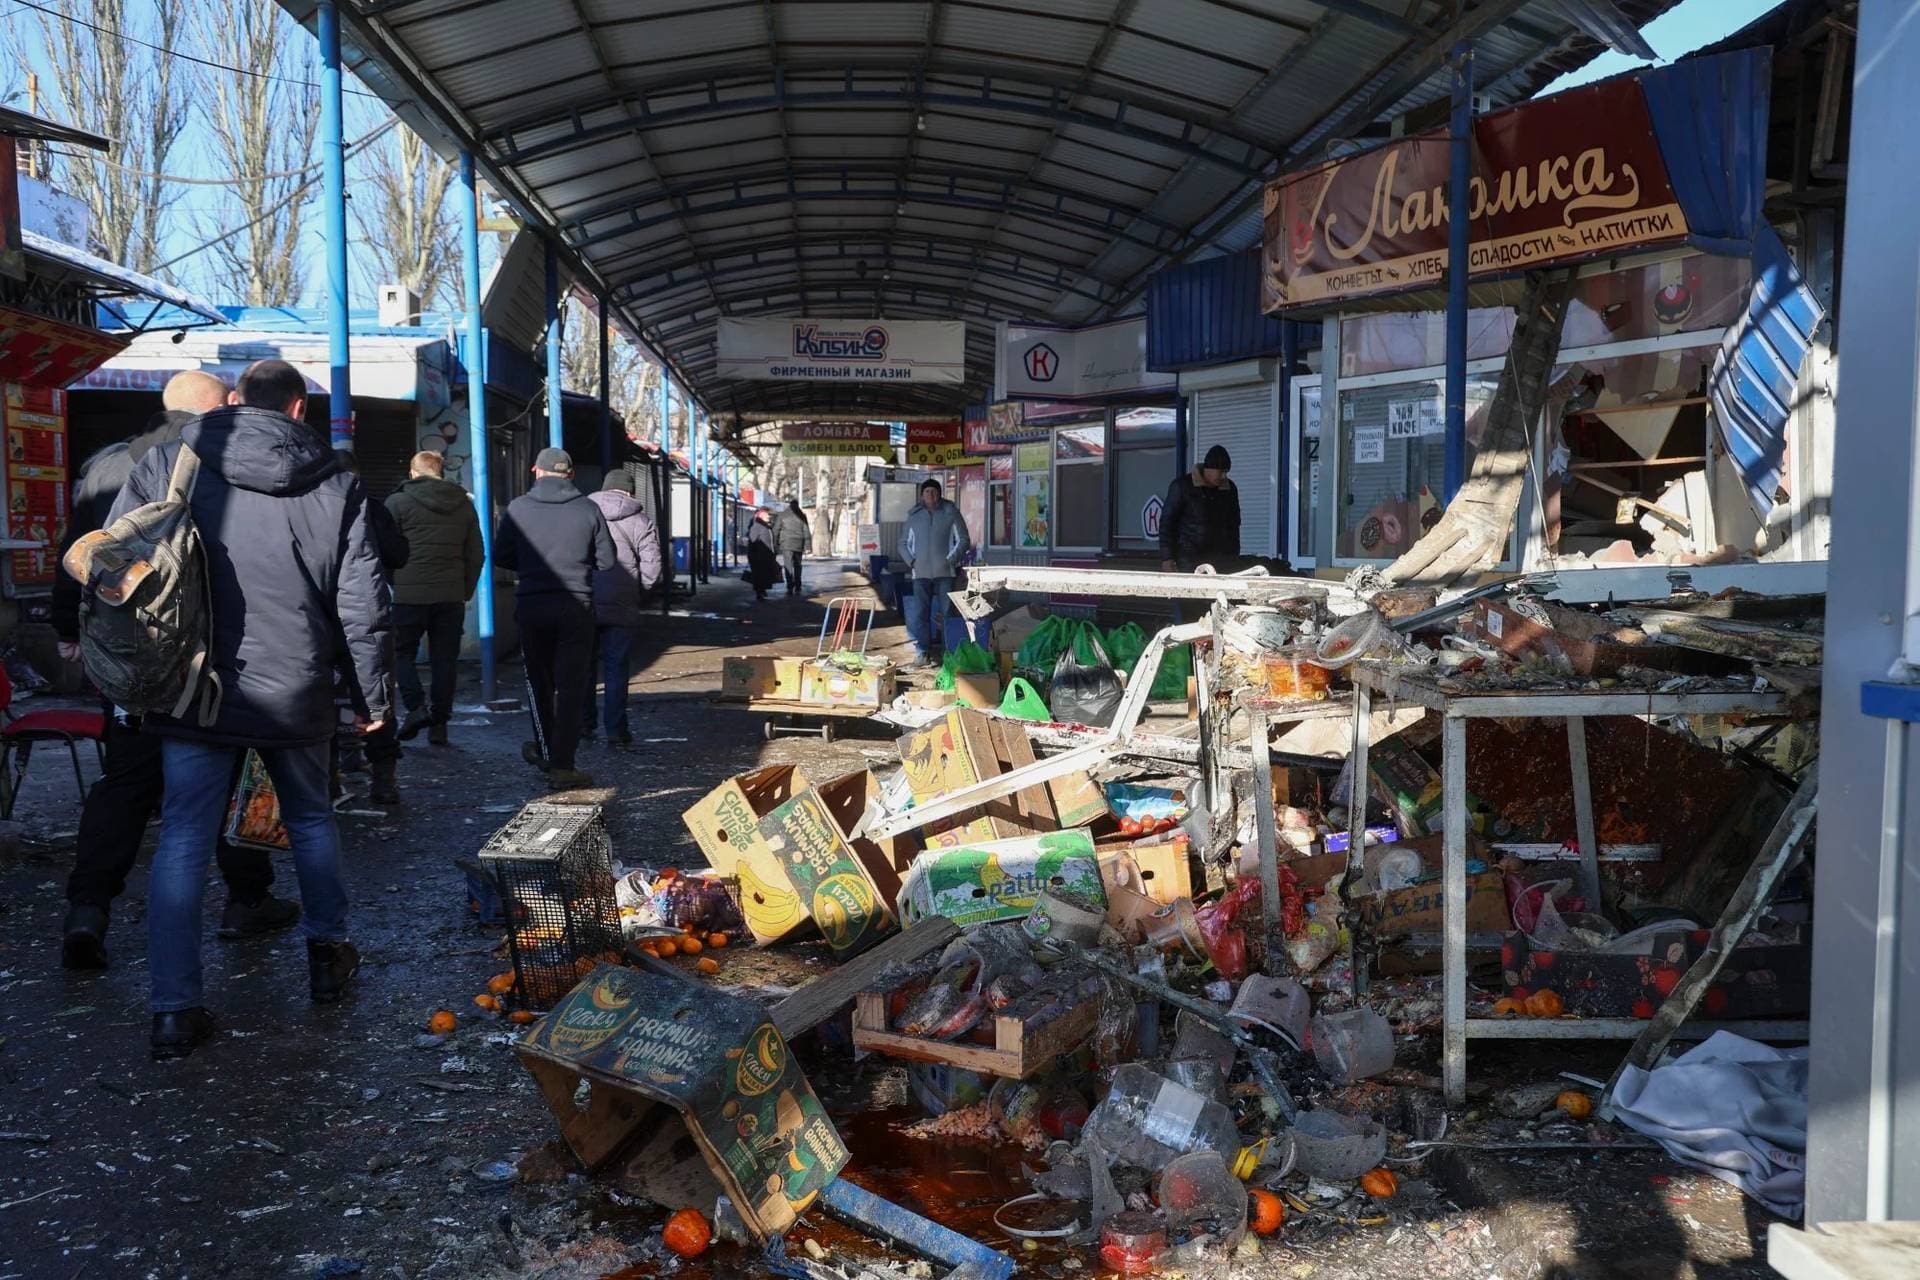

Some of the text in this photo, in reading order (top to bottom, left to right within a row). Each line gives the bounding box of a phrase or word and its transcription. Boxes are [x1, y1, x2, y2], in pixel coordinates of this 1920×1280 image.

[1326, 213, 1674, 292] КОНФЕТЫ ХЛЕБ СЛАДОСТИ НАПИТКИ
[770, 366, 911, 378] ФИРМЕННЫЙ МАГАЗИН
[803, 426, 871, 439] ЛОМБАРД
[1392, 420, 1417, 434] КОФЕ
[1395, 403, 1413, 420] ЧАЙ
[789, 443, 884, 452] ОБМЕН ВАЛЮТ
[714, 803, 749, 853] Village
[724, 789, 758, 835] Global
[782, 814, 829, 877] PREMIUM
[793, 804, 839, 867] BANANAS
[804, 1128, 836, 1172] BANANAS
[812, 1117, 843, 1162] PREMIUM
